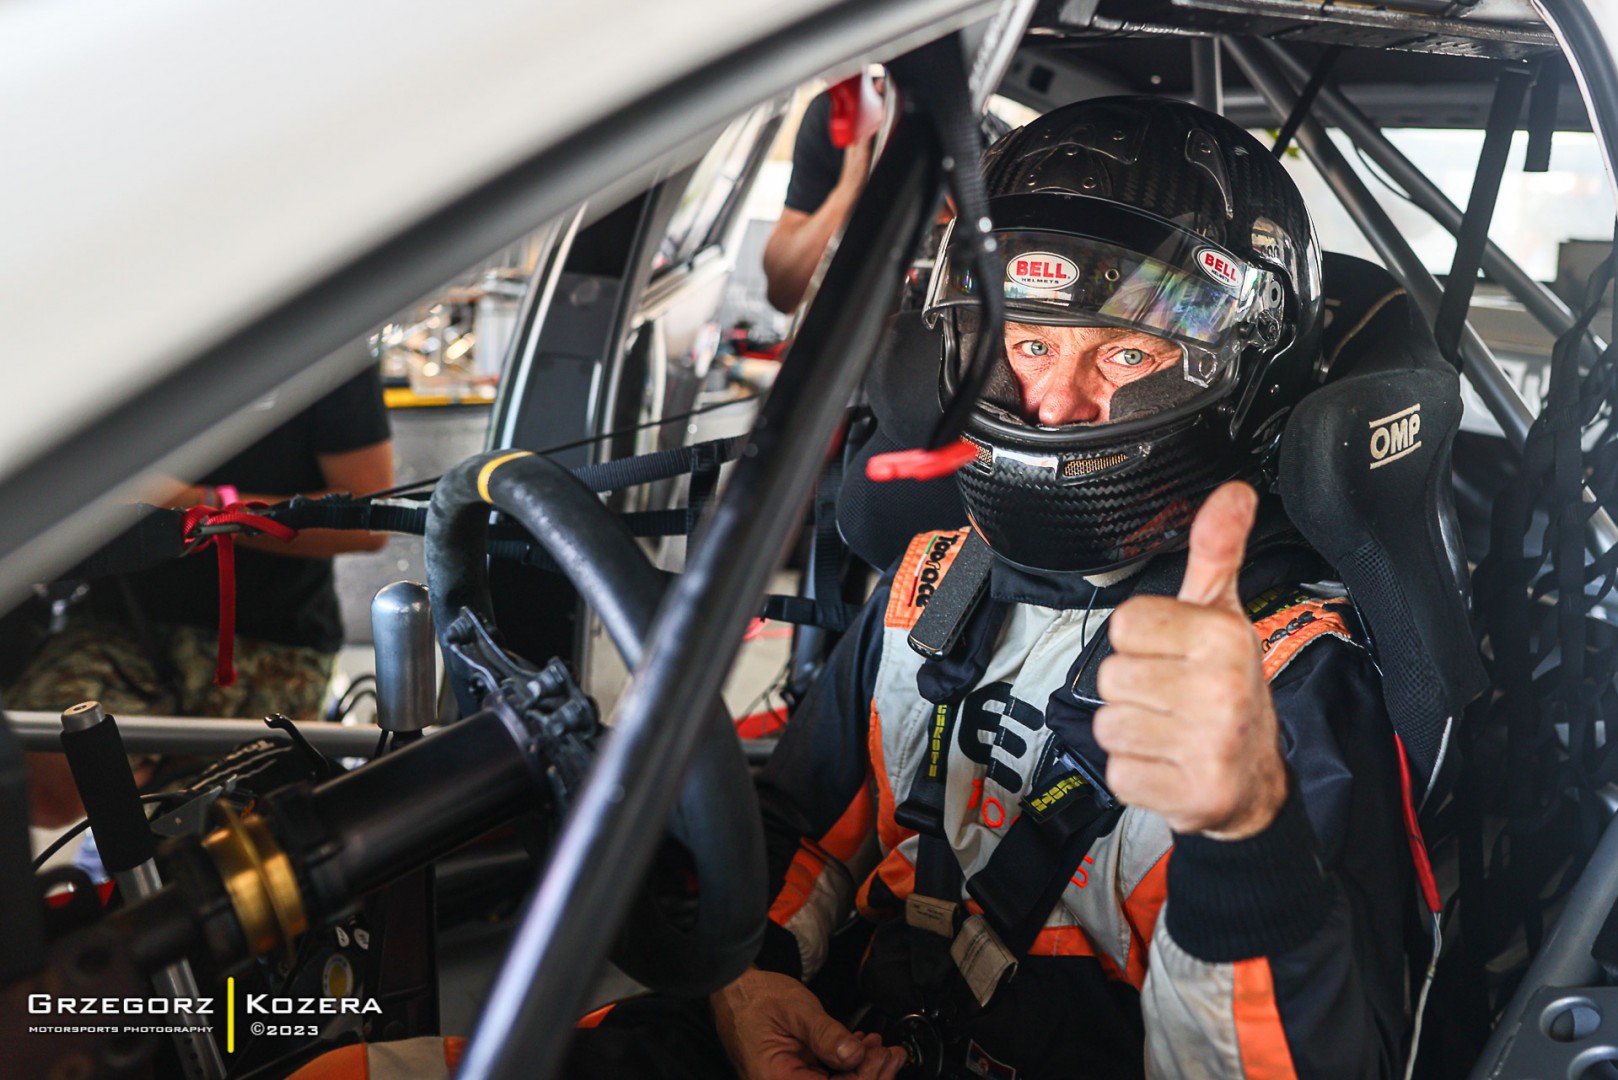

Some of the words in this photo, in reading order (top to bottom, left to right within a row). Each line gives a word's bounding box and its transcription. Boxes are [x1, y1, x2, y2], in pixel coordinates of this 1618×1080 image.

[1016, 260, 1068, 279] BELL
[1204, 252, 1237, 282] BELL
[1021, 277, 1060, 285] HELMETS
[1369, 413, 1421, 460] OMP
